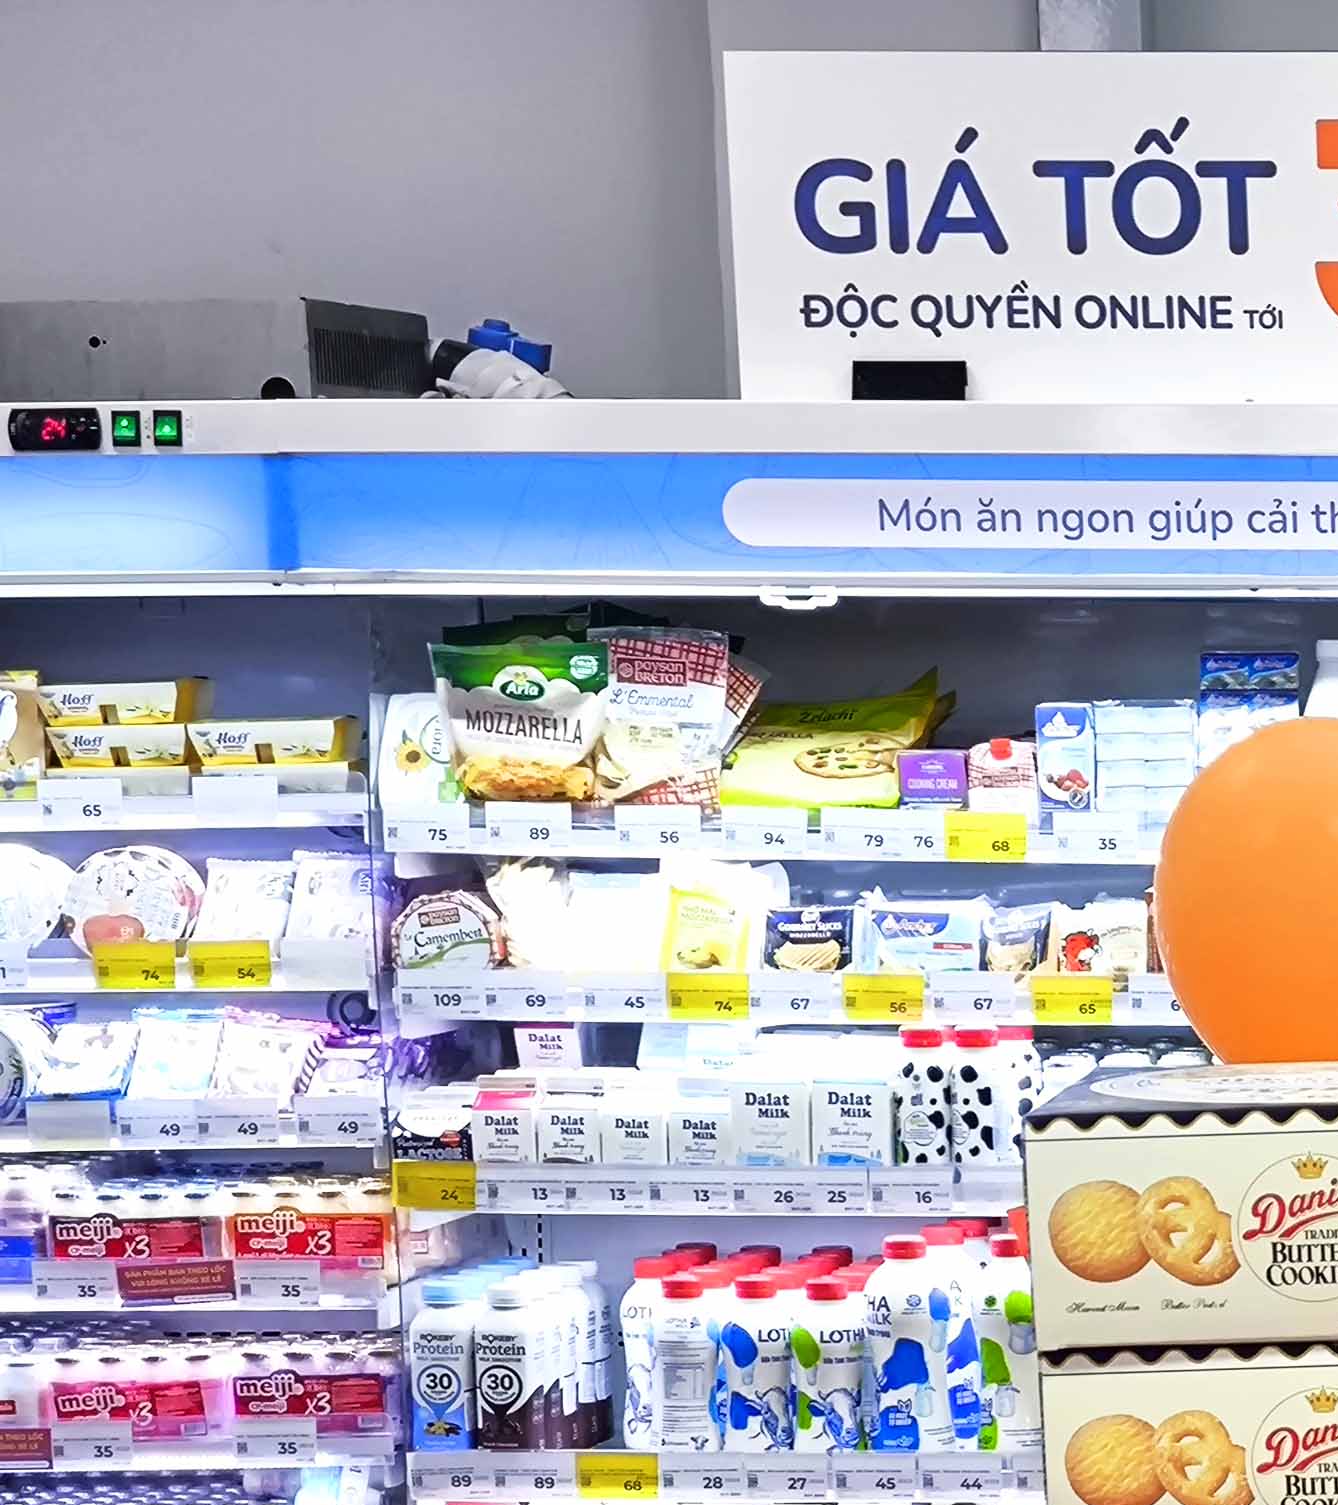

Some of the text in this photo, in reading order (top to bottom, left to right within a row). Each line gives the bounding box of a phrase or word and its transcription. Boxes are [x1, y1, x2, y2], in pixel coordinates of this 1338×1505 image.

[793, 126, 1009, 256] GIÁ
[1032, 116, 1278, 256] TỐT
[800, 280, 1285, 337] ĐỘC QUYỀN ONLINE TỚI
[877, 496, 964, 537] Món
[976, 498, 1025, 537] ăn
[1036, 505, 1141, 549] ngon
[1150, 496, 1234, 550] giúp
[1247, 494, 1301, 537] cải
[505, 682, 540, 697] Arla
[60, 690, 95, 707] Hoff
[465, 708, 584, 746] MOZZARELLA
[72, 735, 105, 749] Hoff
[82, 804, 102, 817] 65
[428, 828, 448, 841] 75
[529, 827, 550, 840] 89
[659, 831, 680, 844] 56
[764, 832, 785, 845] 94
[864, 835, 884, 848] 79
[914, 836, 934, 849] 76
[991, 840, 1011, 853] 68
[1098, 838, 1117, 851] 35
[413, 927, 483, 948] Camembert
[142, 968, 160, 981] 74
[237, 967, 256, 980] 54
[433, 994, 462, 1007] 109
[525, 994, 546, 1007] 69
[624, 995, 645, 1008] 45
[714, 1000, 733, 1012] 74
[790, 998, 810, 1010] 67
[973, 998, 993, 1010] 67
[889, 1002, 907, 1014] 56
[1079, 1003, 1097, 1015] 65
[528, 1033, 563, 1043] Dalat
[745, 1092, 790, 1107] Dalat
[827, 1091, 873, 1106] Dalat
[159, 1123, 181, 1136] 49
[237, 1122, 259, 1135] 49
[337, 1121, 358, 1133] 49
[440, 1189, 459, 1201] 24
[531, 1188, 548, 1201] 13
[609, 1188, 627, 1201] 13
[693, 1189, 710, 1202] 13
[773, 1190, 794, 1203] 26
[827, 1190, 847, 1203] 25
[915, 1191, 932, 1203] 16
[57, 1218, 114, 1241] meiji
[237, 1210, 297, 1236] meiji
[78, 1284, 97, 1297] 35
[281, 1284, 301, 1297] 35
[412, 1342, 465, 1355] Protein
[475, 1343, 527, 1356] Protein
[238, 1375, 298, 1399] meiji
[425, 1373, 452, 1390] 30
[486, 1373, 514, 1391] 30
[450, 1475, 472, 1488] 89
[534, 1477, 555, 1489] 89
[623, 1480, 642, 1492] 68
[702, 1477, 723, 1489] 28
[787, 1478, 807, 1490] 27
[875, 1478, 896, 1490] 45
[960, 1478, 982, 1490] 44
